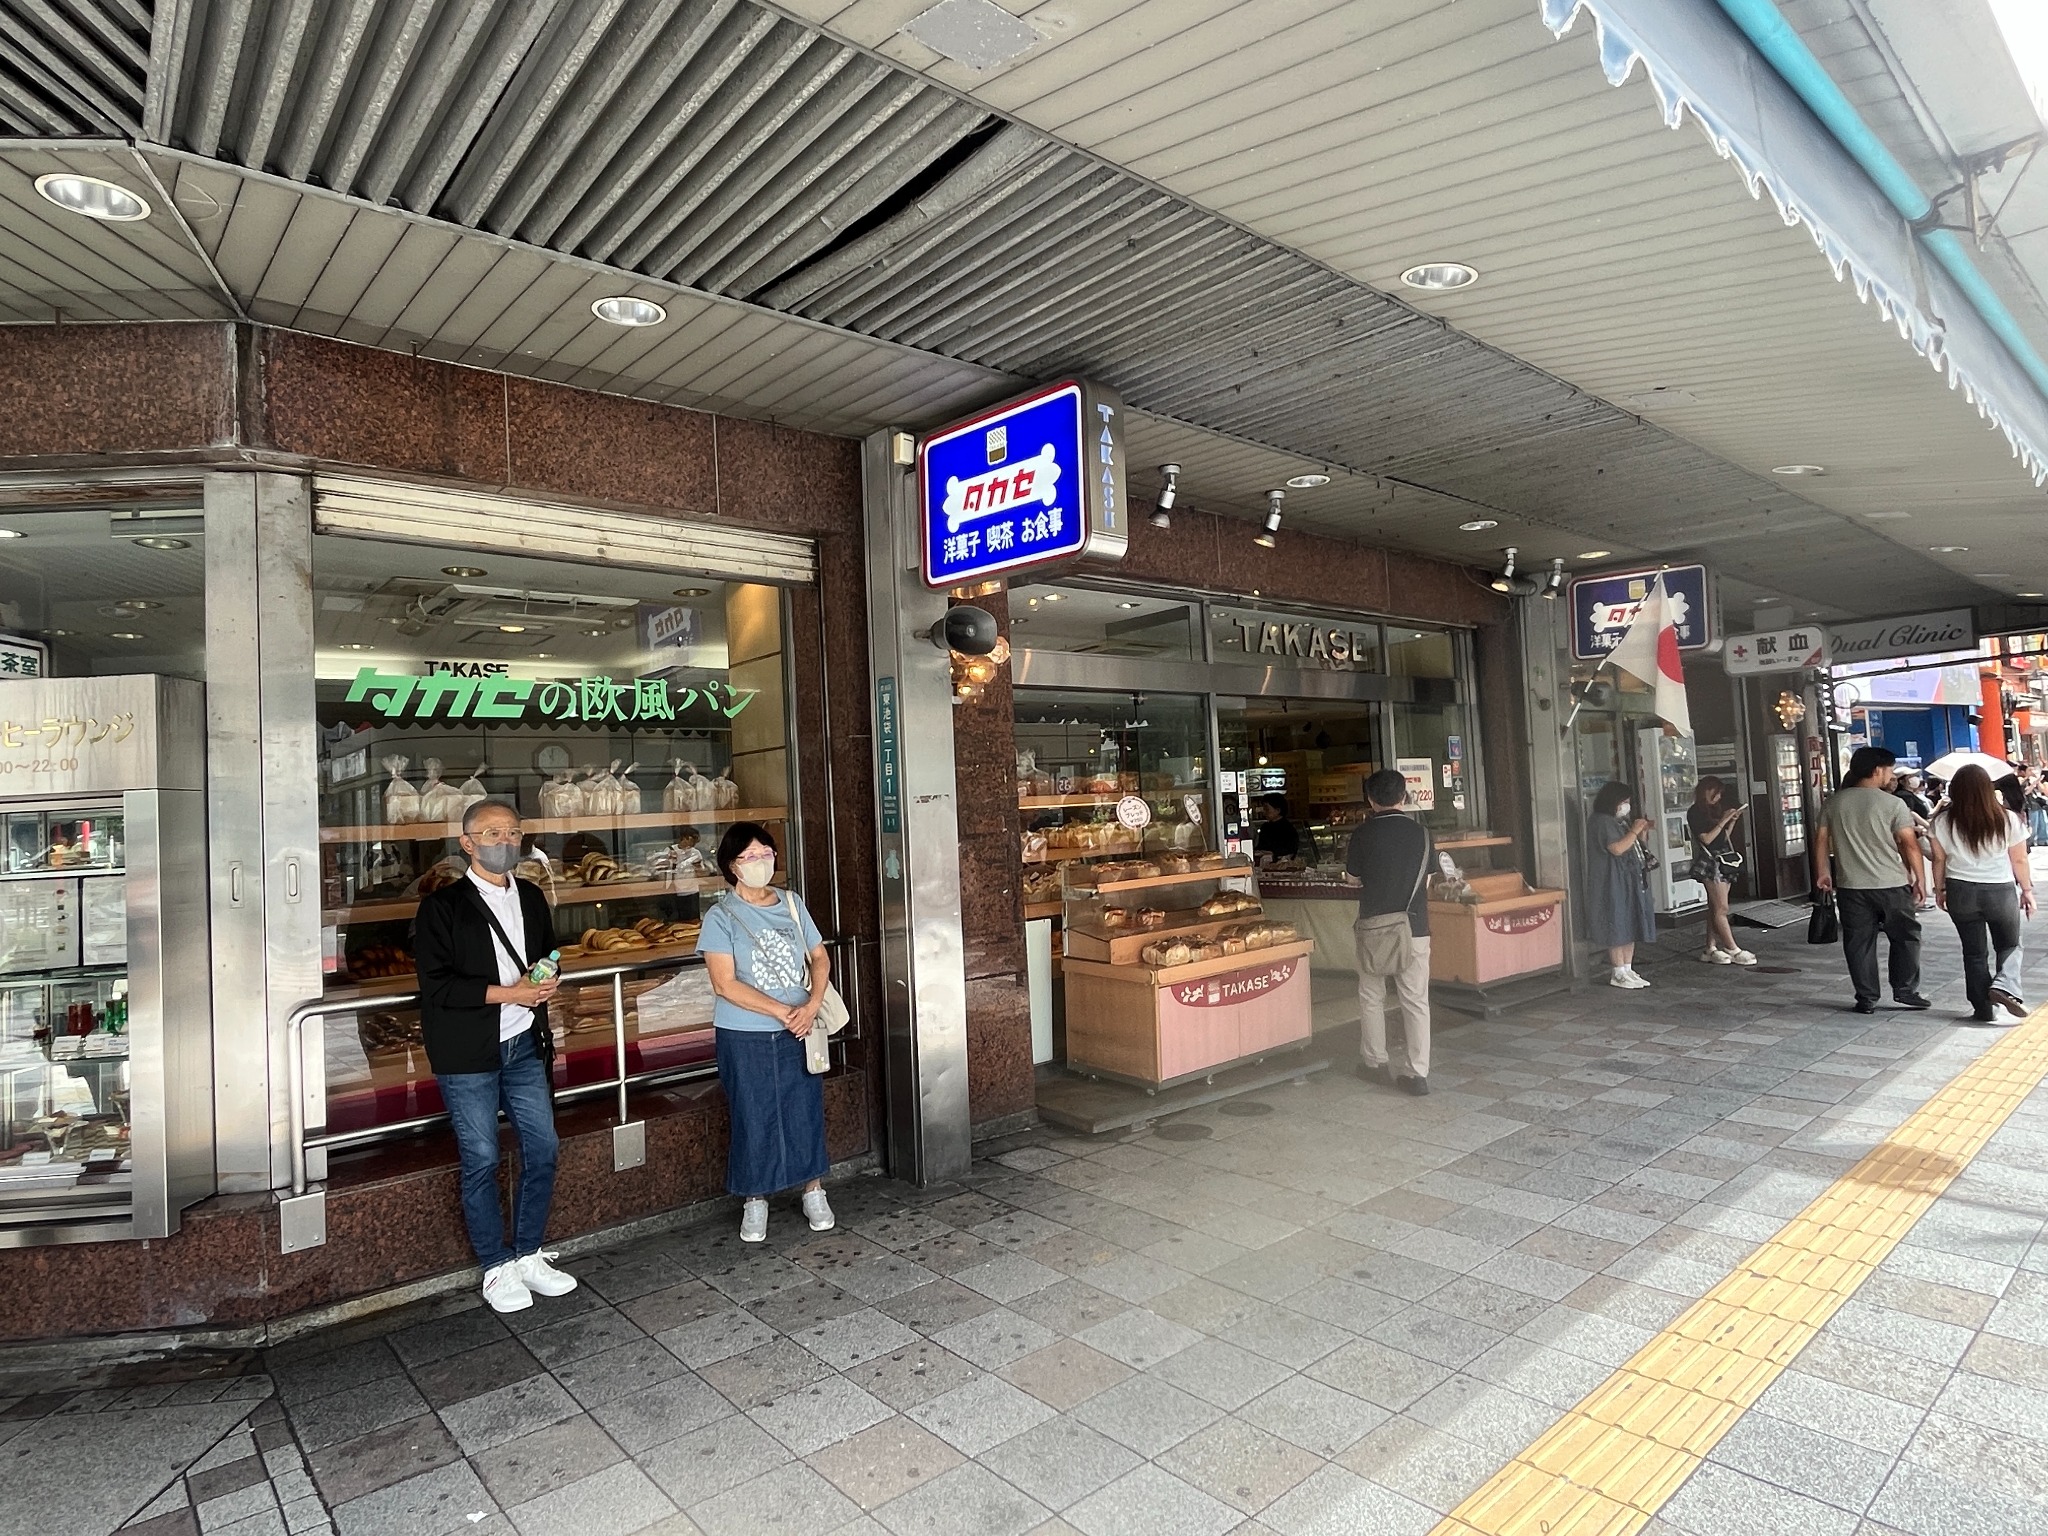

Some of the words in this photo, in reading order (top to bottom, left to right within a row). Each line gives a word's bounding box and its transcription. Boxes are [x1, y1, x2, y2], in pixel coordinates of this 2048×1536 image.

[962, 468, 1036, 512] タカセ
[943, 531, 981, 565] 洋菓子
[986, 520, 1014, 554] 喫茶
[1021, 507, 1063, 543] お食事
[1233, 618, 1367, 662] TAKASE
[1756, 633, 1808, 655] 献血
[1830, 629, 1886, 655] Dual
[1888, 624, 1967, 647] Clinic
[424, 661, 509, 678] TAKASE
[345, 667, 757, 723] タカセの欧風パン
[0, 711, 134, 748] ヒーラウンジ
[1222, 975, 1270, 998] TAKASE
